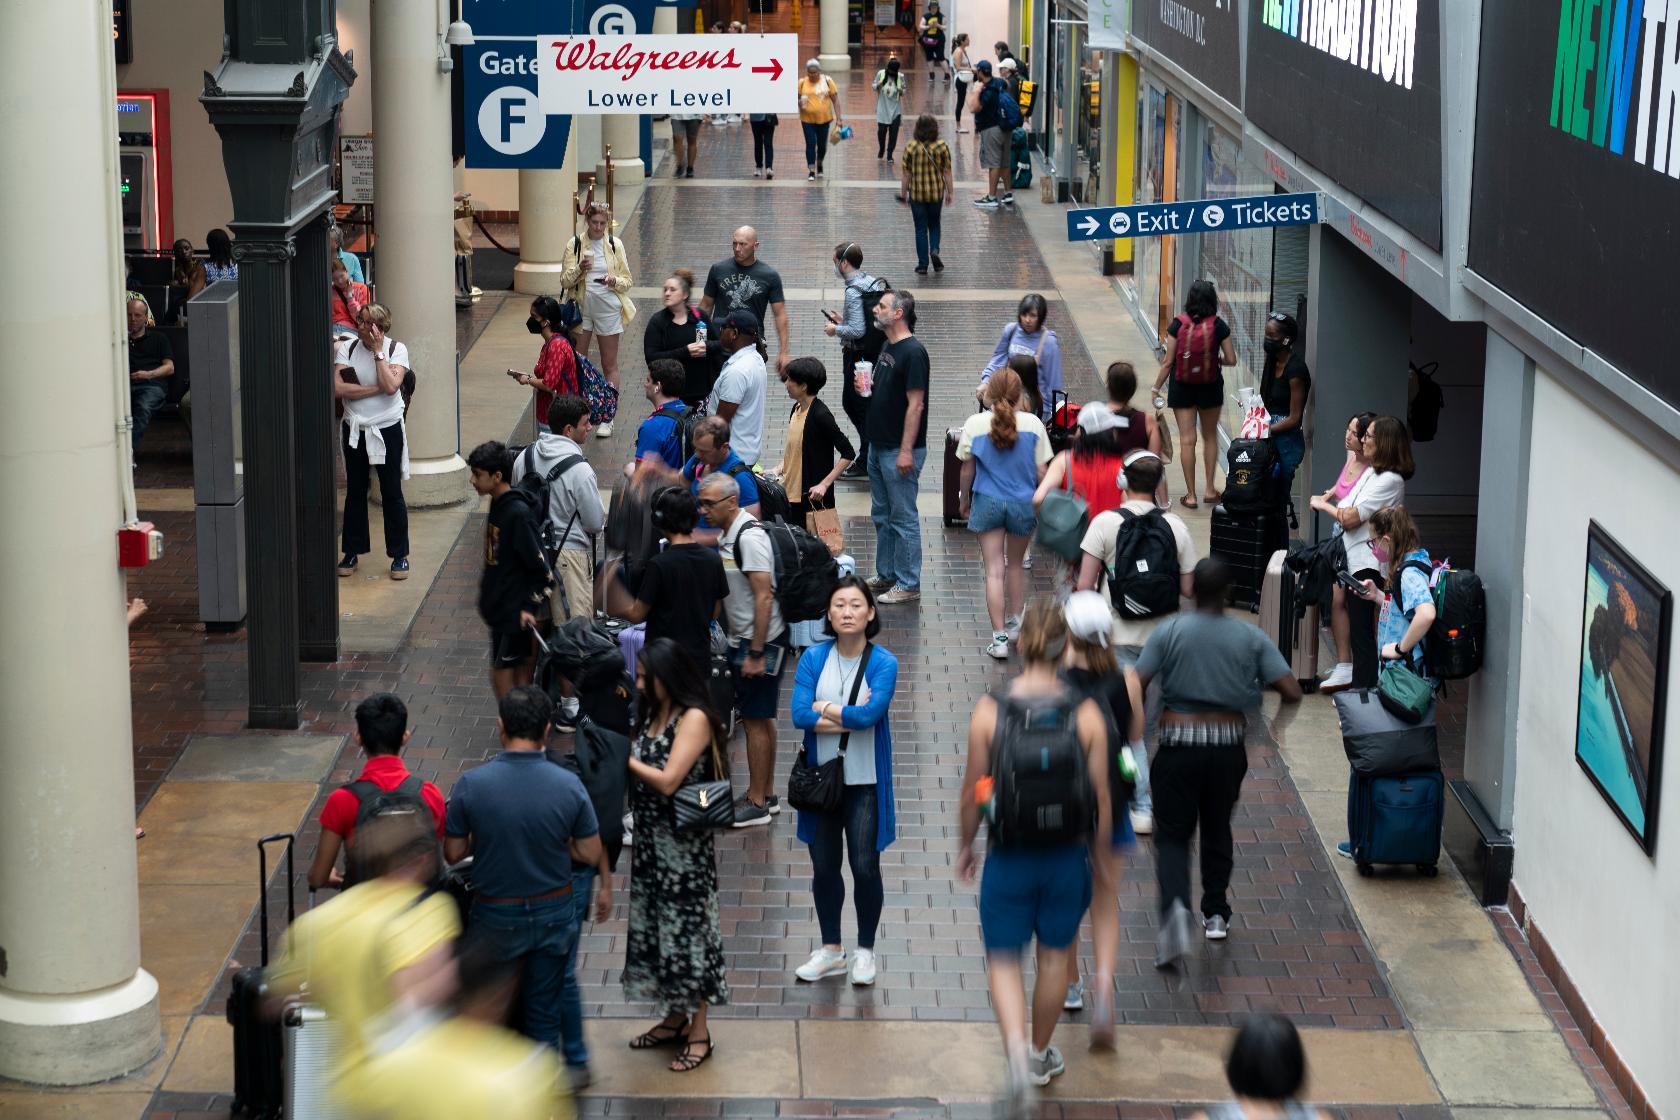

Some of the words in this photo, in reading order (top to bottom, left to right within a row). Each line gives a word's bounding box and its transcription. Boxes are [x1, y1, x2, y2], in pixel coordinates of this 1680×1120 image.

[598, 12, 624, 35] G
[551, 38, 742, 82] Walgreens
[1550, 0, 1643, 156] NEW
[588, 89, 658, 107] Lower
[670, 88, 732, 107] Level
[499, 97, 527, 143] F
[1137, 209, 1180, 232] Exit
[1231, 201, 1312, 225] Tickets
